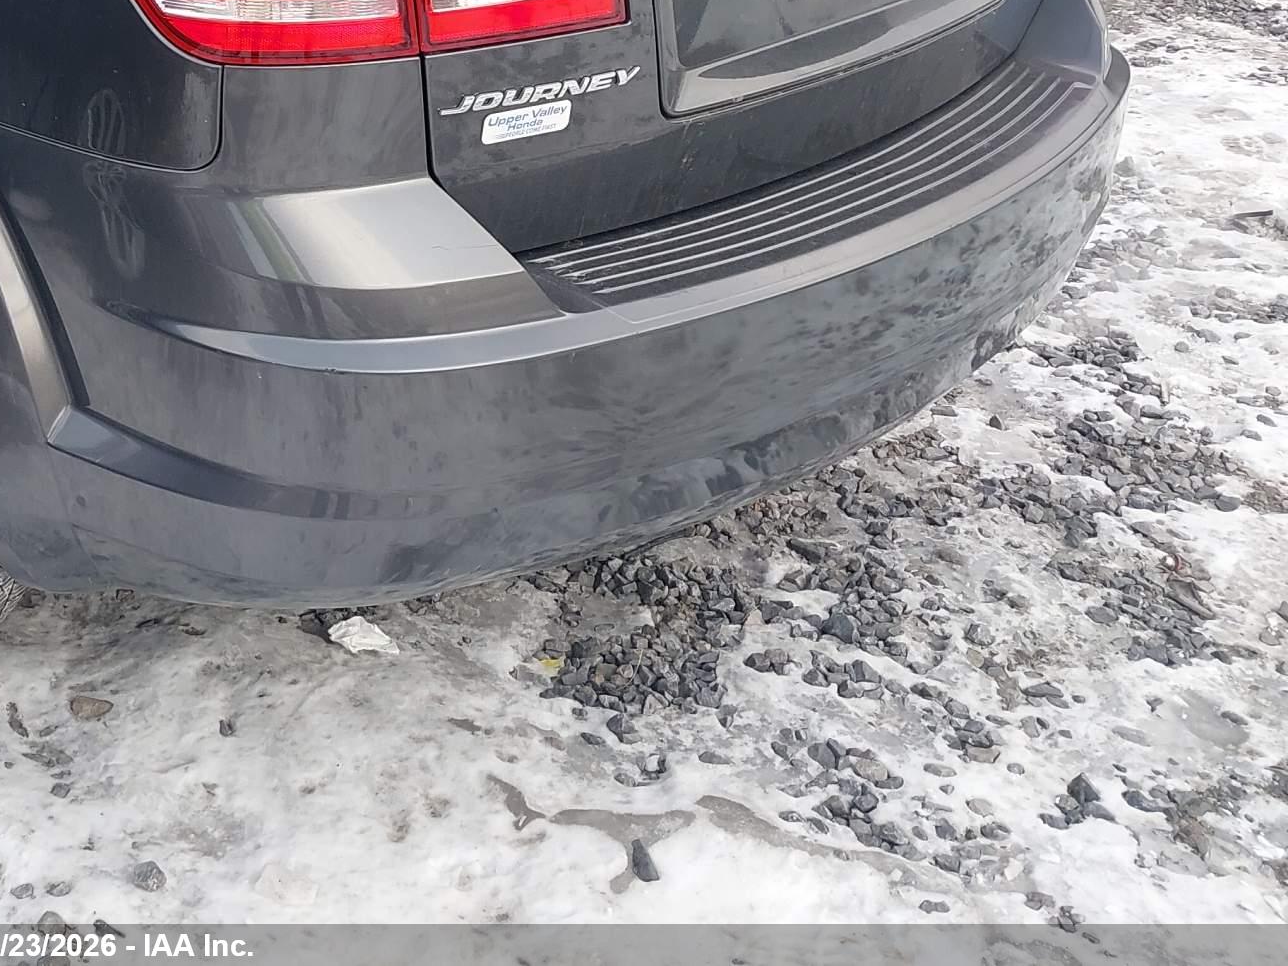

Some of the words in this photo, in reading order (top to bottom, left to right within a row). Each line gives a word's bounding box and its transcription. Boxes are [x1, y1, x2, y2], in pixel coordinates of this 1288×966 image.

[438, 65, 641, 116] JOURNEY
[487, 113, 529, 127] Upper
[532, 105, 568, 119] Valley
[507, 118, 544, 132] Honda
